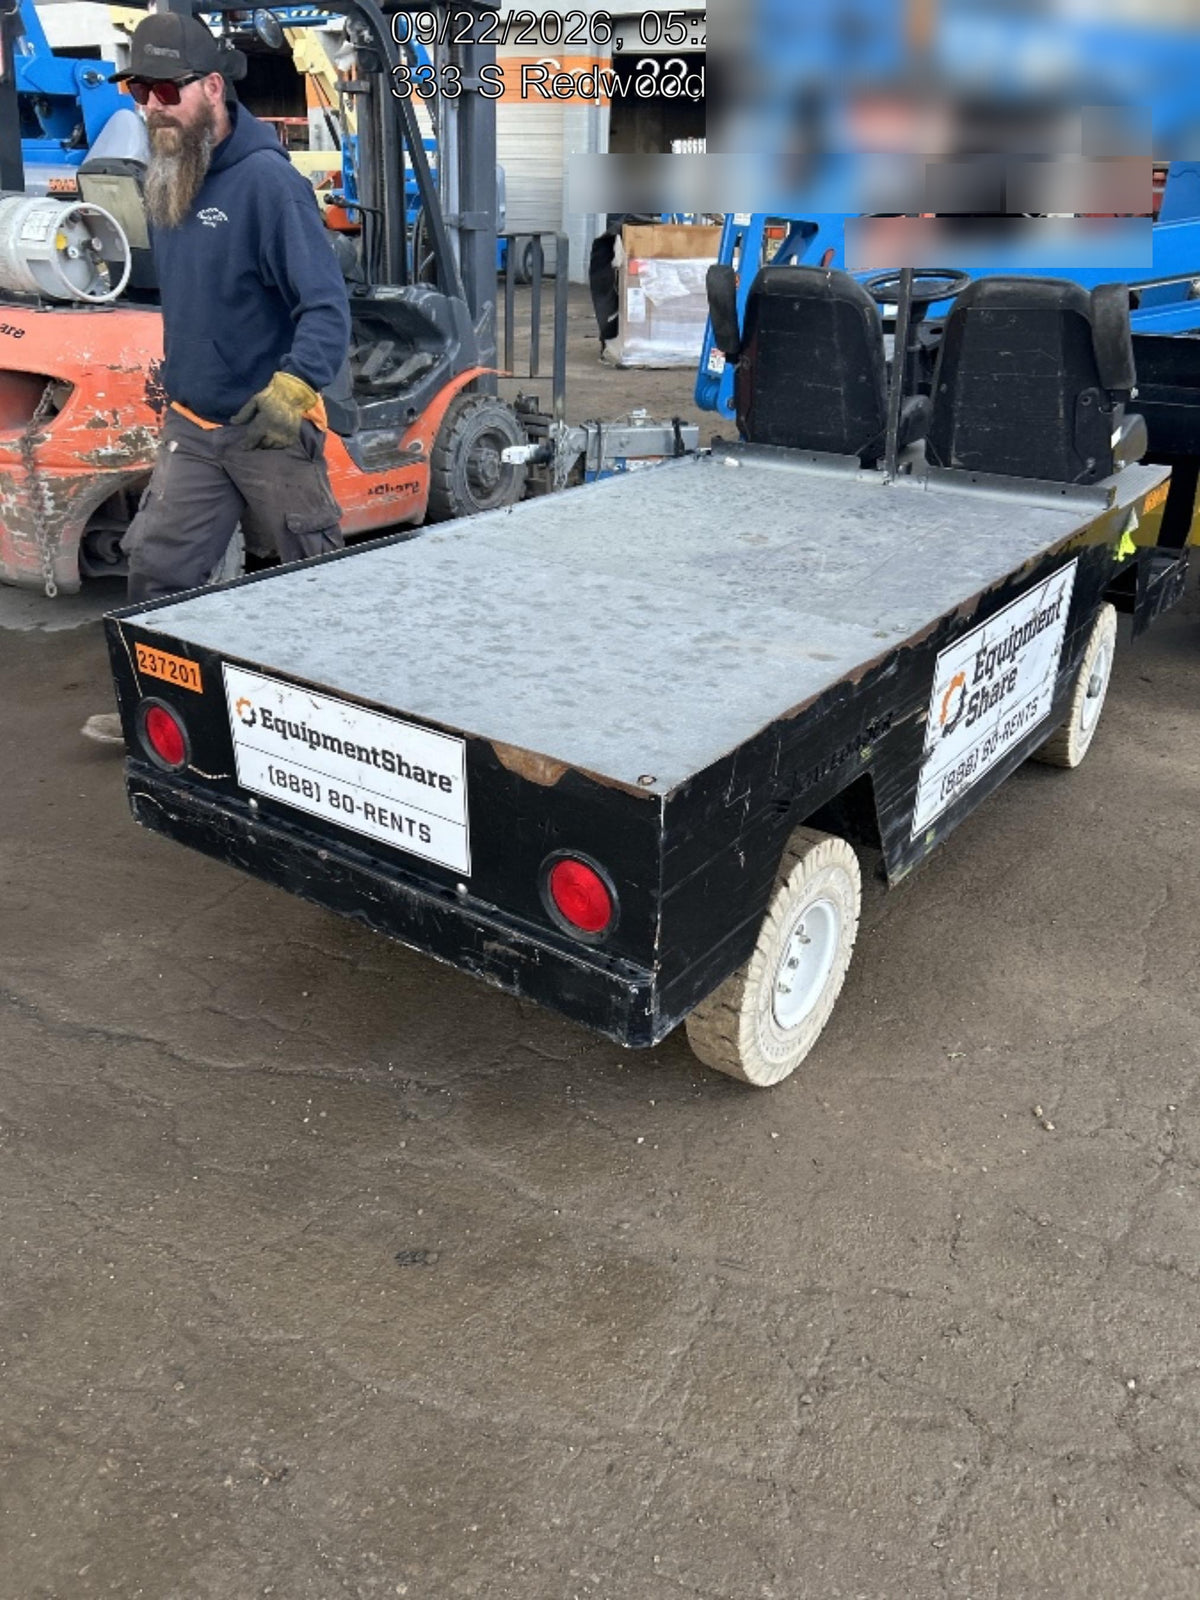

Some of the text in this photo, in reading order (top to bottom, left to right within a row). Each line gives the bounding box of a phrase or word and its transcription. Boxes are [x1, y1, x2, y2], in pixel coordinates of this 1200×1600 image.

[138, 650, 198, 687] 237201
[972, 594, 1064, 685] Equipment
[965, 667, 1018, 727] Share
[259, 707, 453, 794] EquipmentShare
[267, 765, 432, 844] (888) 80-RENTS
